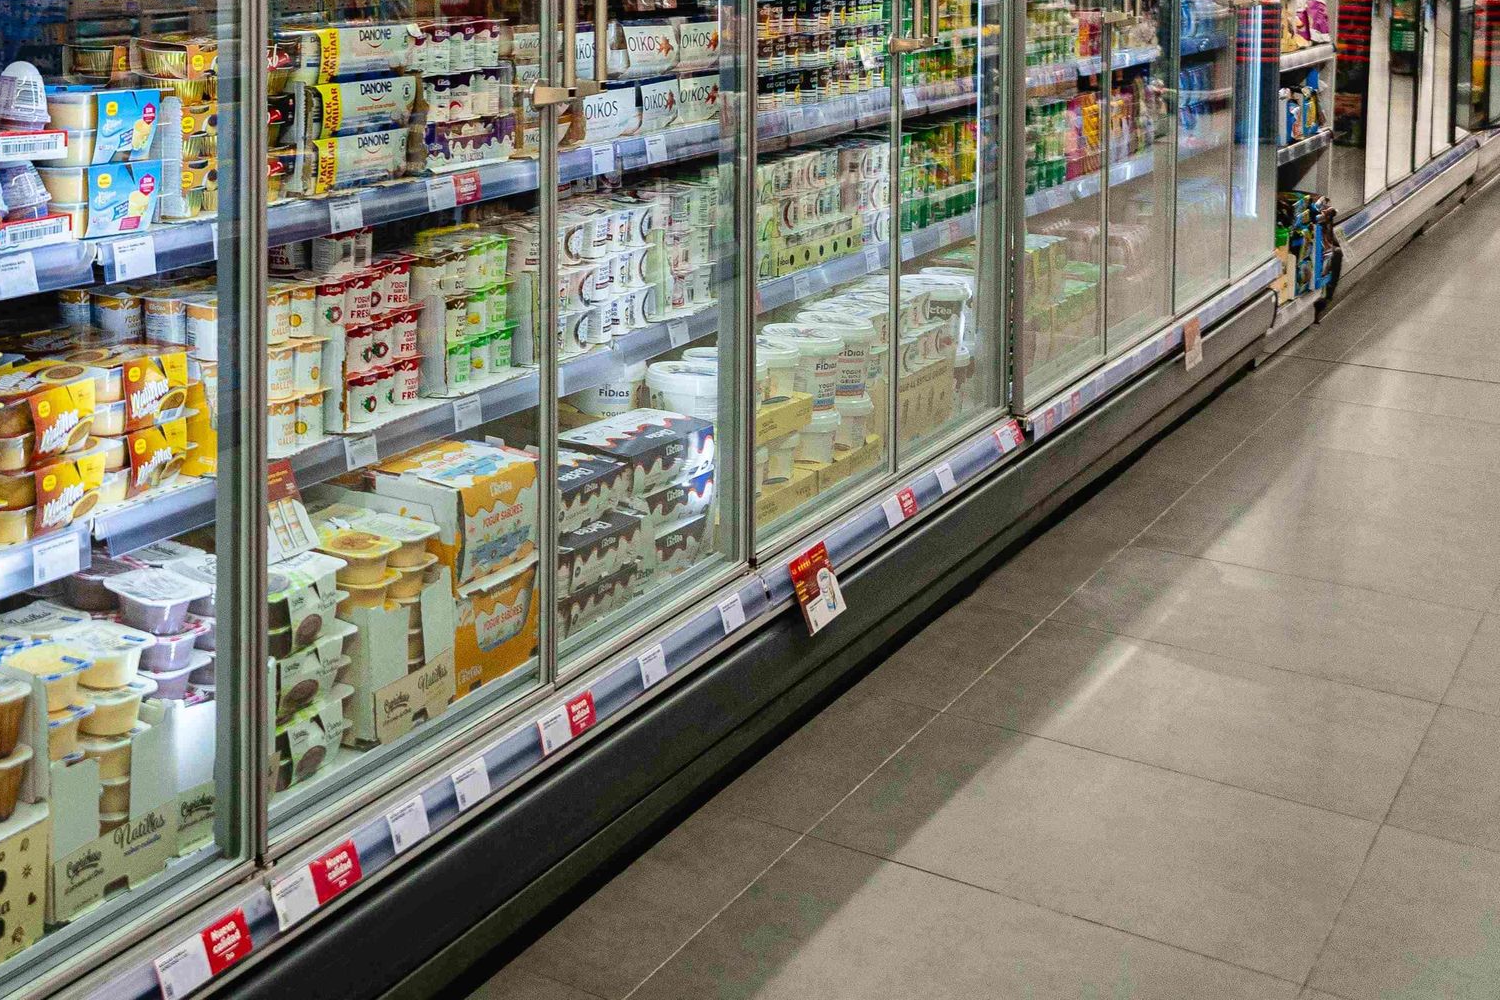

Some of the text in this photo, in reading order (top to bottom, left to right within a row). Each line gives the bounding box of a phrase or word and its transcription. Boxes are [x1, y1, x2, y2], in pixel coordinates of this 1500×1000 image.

[628, 33, 661, 53] OIKOS
[682, 30, 711, 50] OIKOS
[321, 45, 330, 75] PACK
[644, 91, 668, 111] OIKOS
[680, 85, 711, 103] OIKOS
[324, 101, 333, 131] PACK
[584, 100, 619, 120] OIKOS
[319, 154, 328, 184] PACK
[113, 810, 166, 849] Natillas
[325, 850, 350, 870] Nueva
[326, 861, 353, 885] calidad
[209, 919, 239, 942] Nueva
[211, 930, 242, 956] calidad
